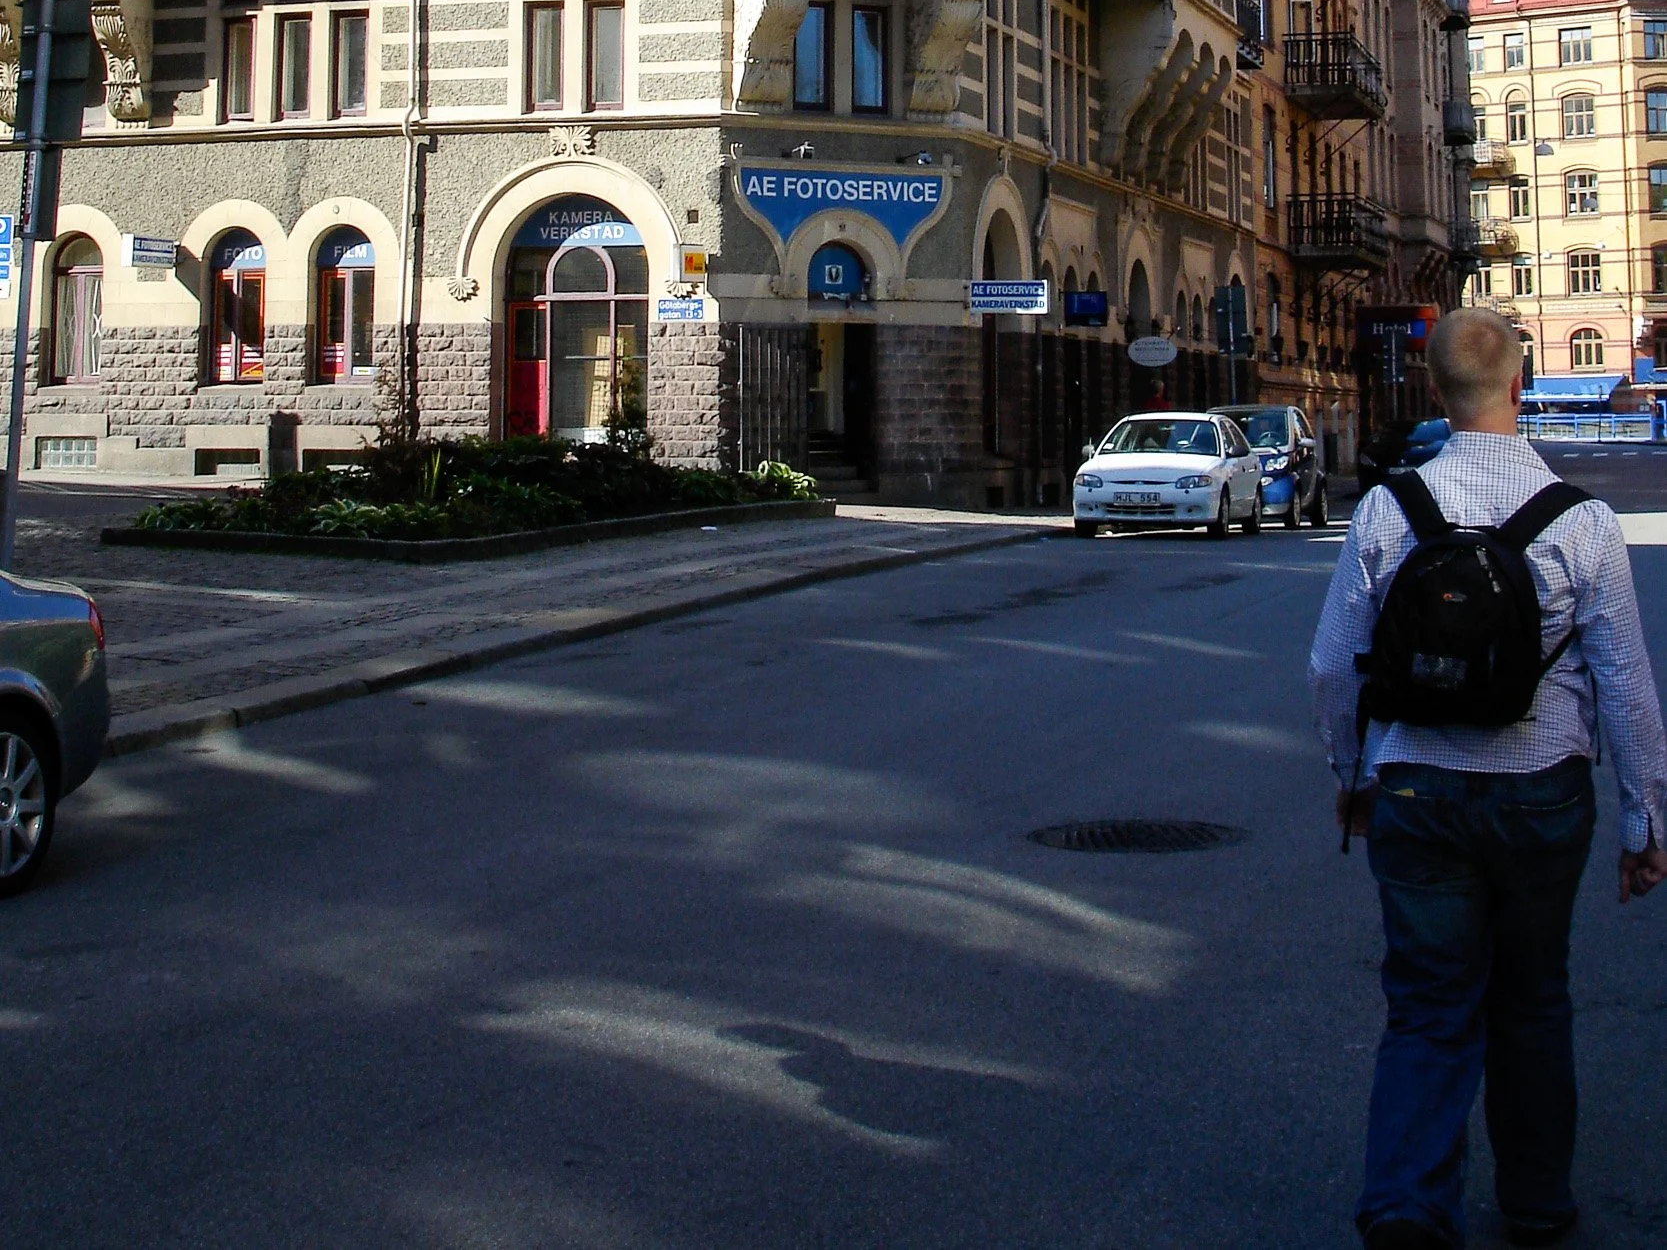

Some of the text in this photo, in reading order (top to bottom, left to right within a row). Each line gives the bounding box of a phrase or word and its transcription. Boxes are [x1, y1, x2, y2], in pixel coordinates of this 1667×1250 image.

[746, 176, 938, 202] AE FOTOSERVICE
[549, 210, 614, 224] KAMERA
[540, 225, 625, 240] VERKSTAD
[224, 248, 263, 261] FOTO
[334, 245, 367, 258] FILM
[972, 285, 1045, 296] AE FOTOSERVICE
[971, 299, 1045, 309] KAMERAVERKSTAD
[1140, 493, 1158, 503] 554
